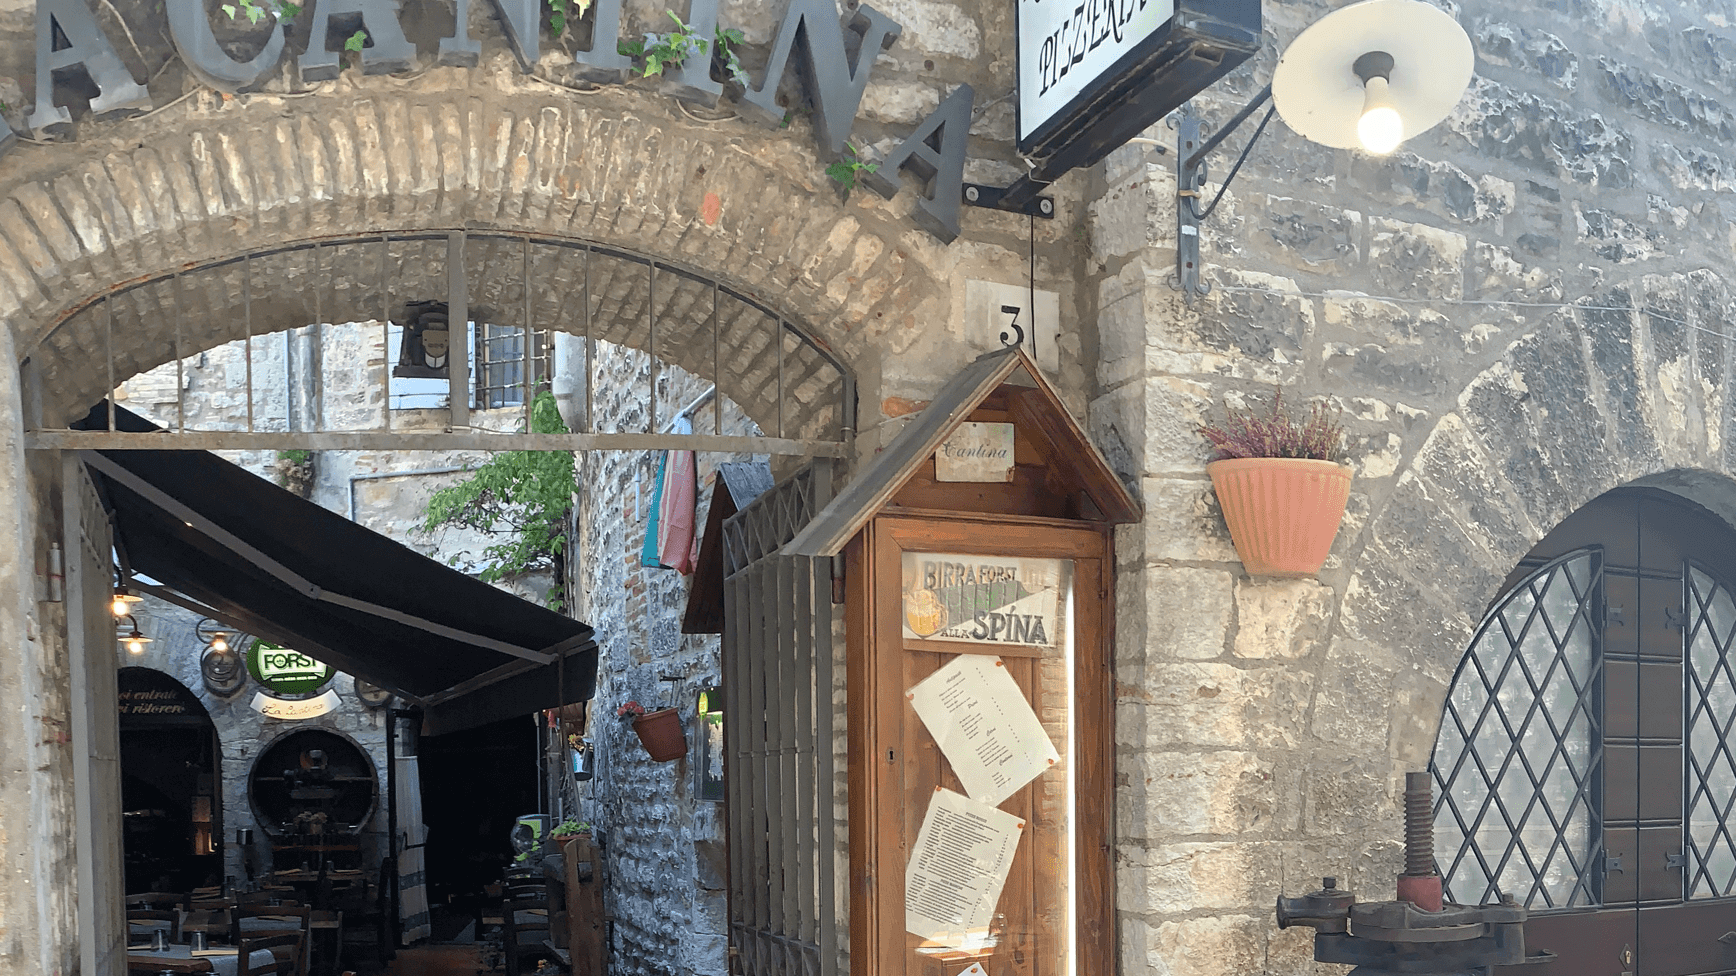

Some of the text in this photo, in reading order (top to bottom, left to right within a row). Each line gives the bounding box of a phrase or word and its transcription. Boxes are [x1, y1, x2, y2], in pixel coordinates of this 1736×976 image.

[1000, 304, 1024, 346] 3
[942, 441, 1007, 459] Cantina
[923, 560, 977, 589] BIRRA
[940, 628, 970, 639] ALLA
